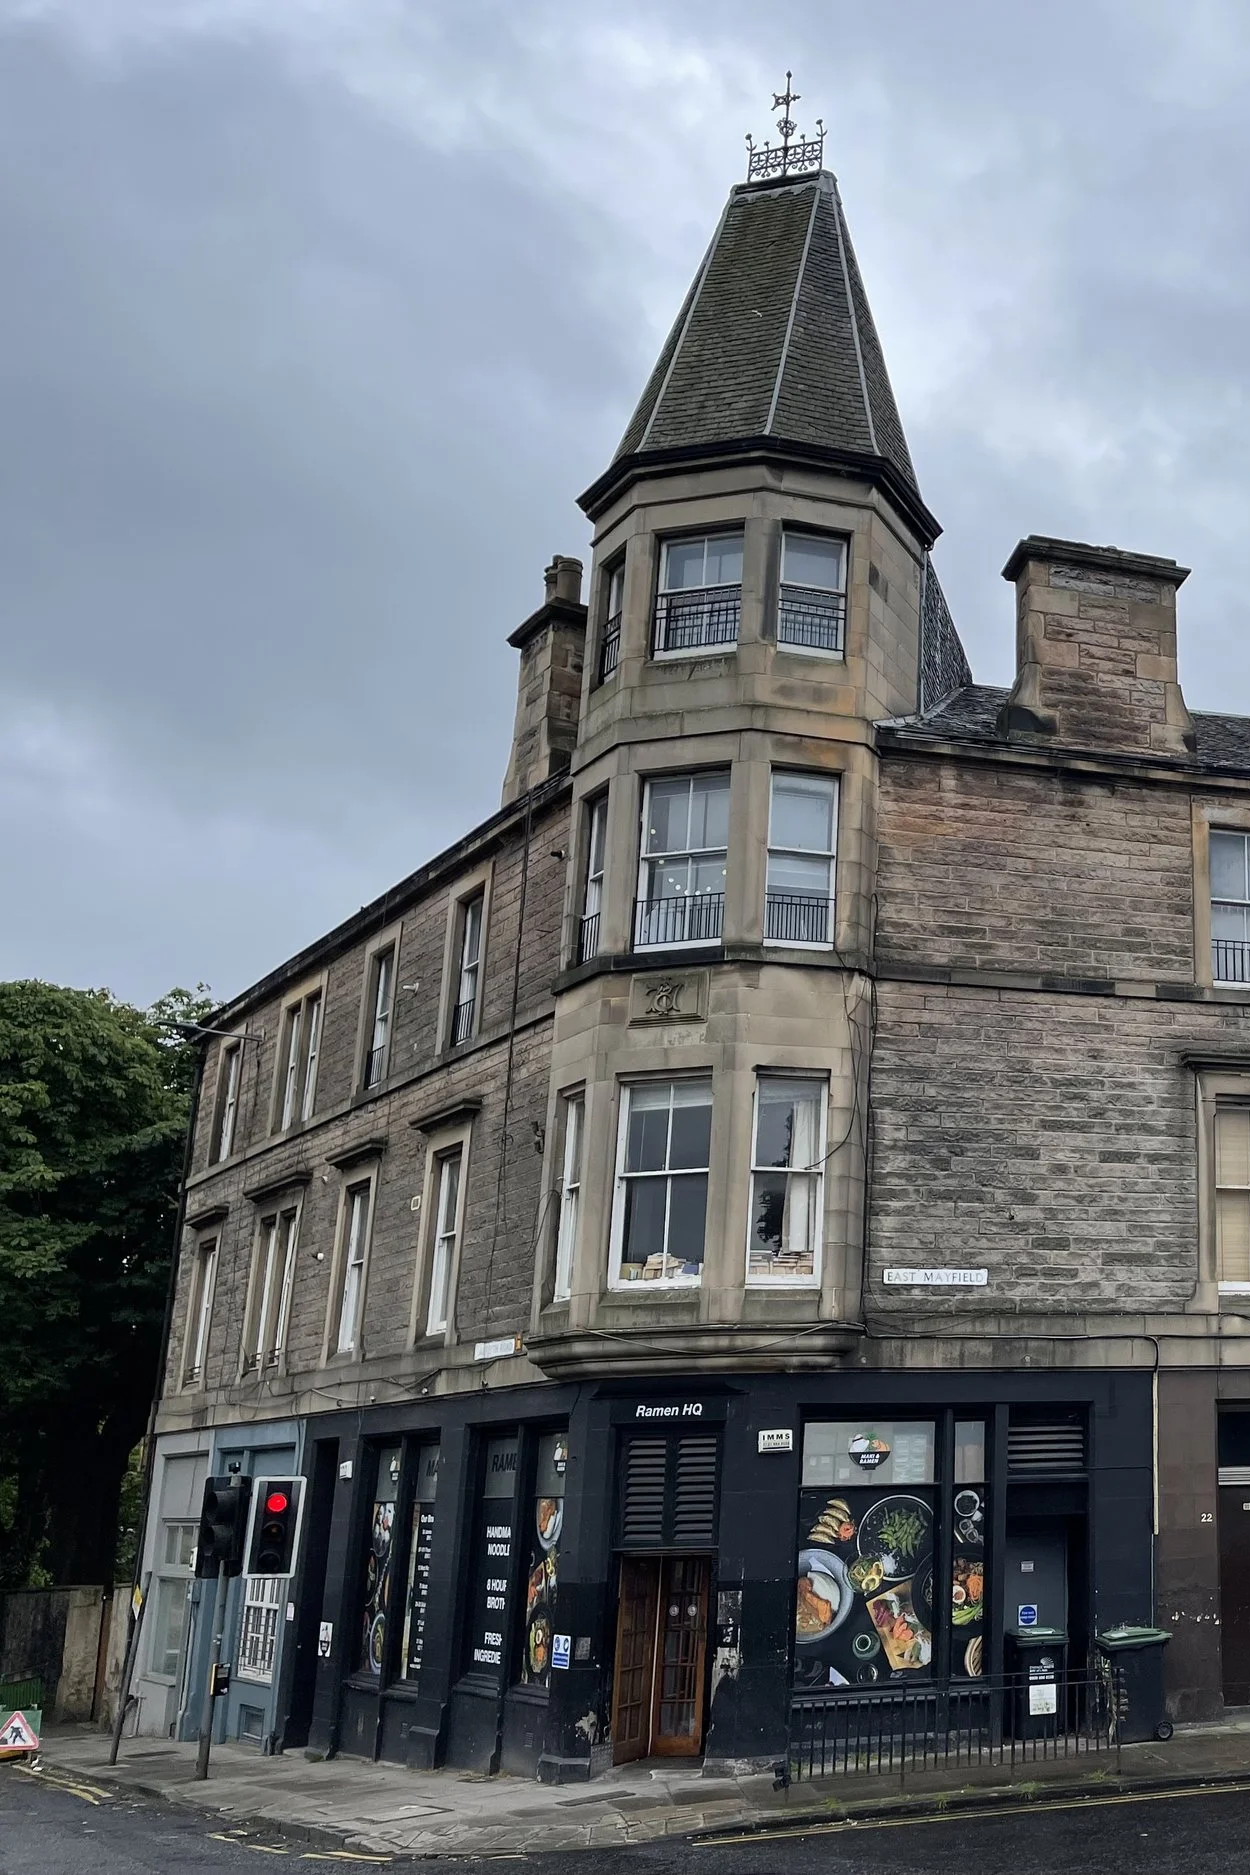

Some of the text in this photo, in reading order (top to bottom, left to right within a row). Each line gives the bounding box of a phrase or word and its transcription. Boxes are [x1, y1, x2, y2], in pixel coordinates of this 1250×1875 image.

[887, 1272, 984, 1283] EAST MAYFIELD
[635, 1403, 703, 1417] Ramen HQ
[762, 1433, 790, 1441] IMMS
[1200, 1513, 1213, 1522] 22
[486, 1579, 491, 1591] 8
[473, 1648, 501, 1665] INGREDIE
